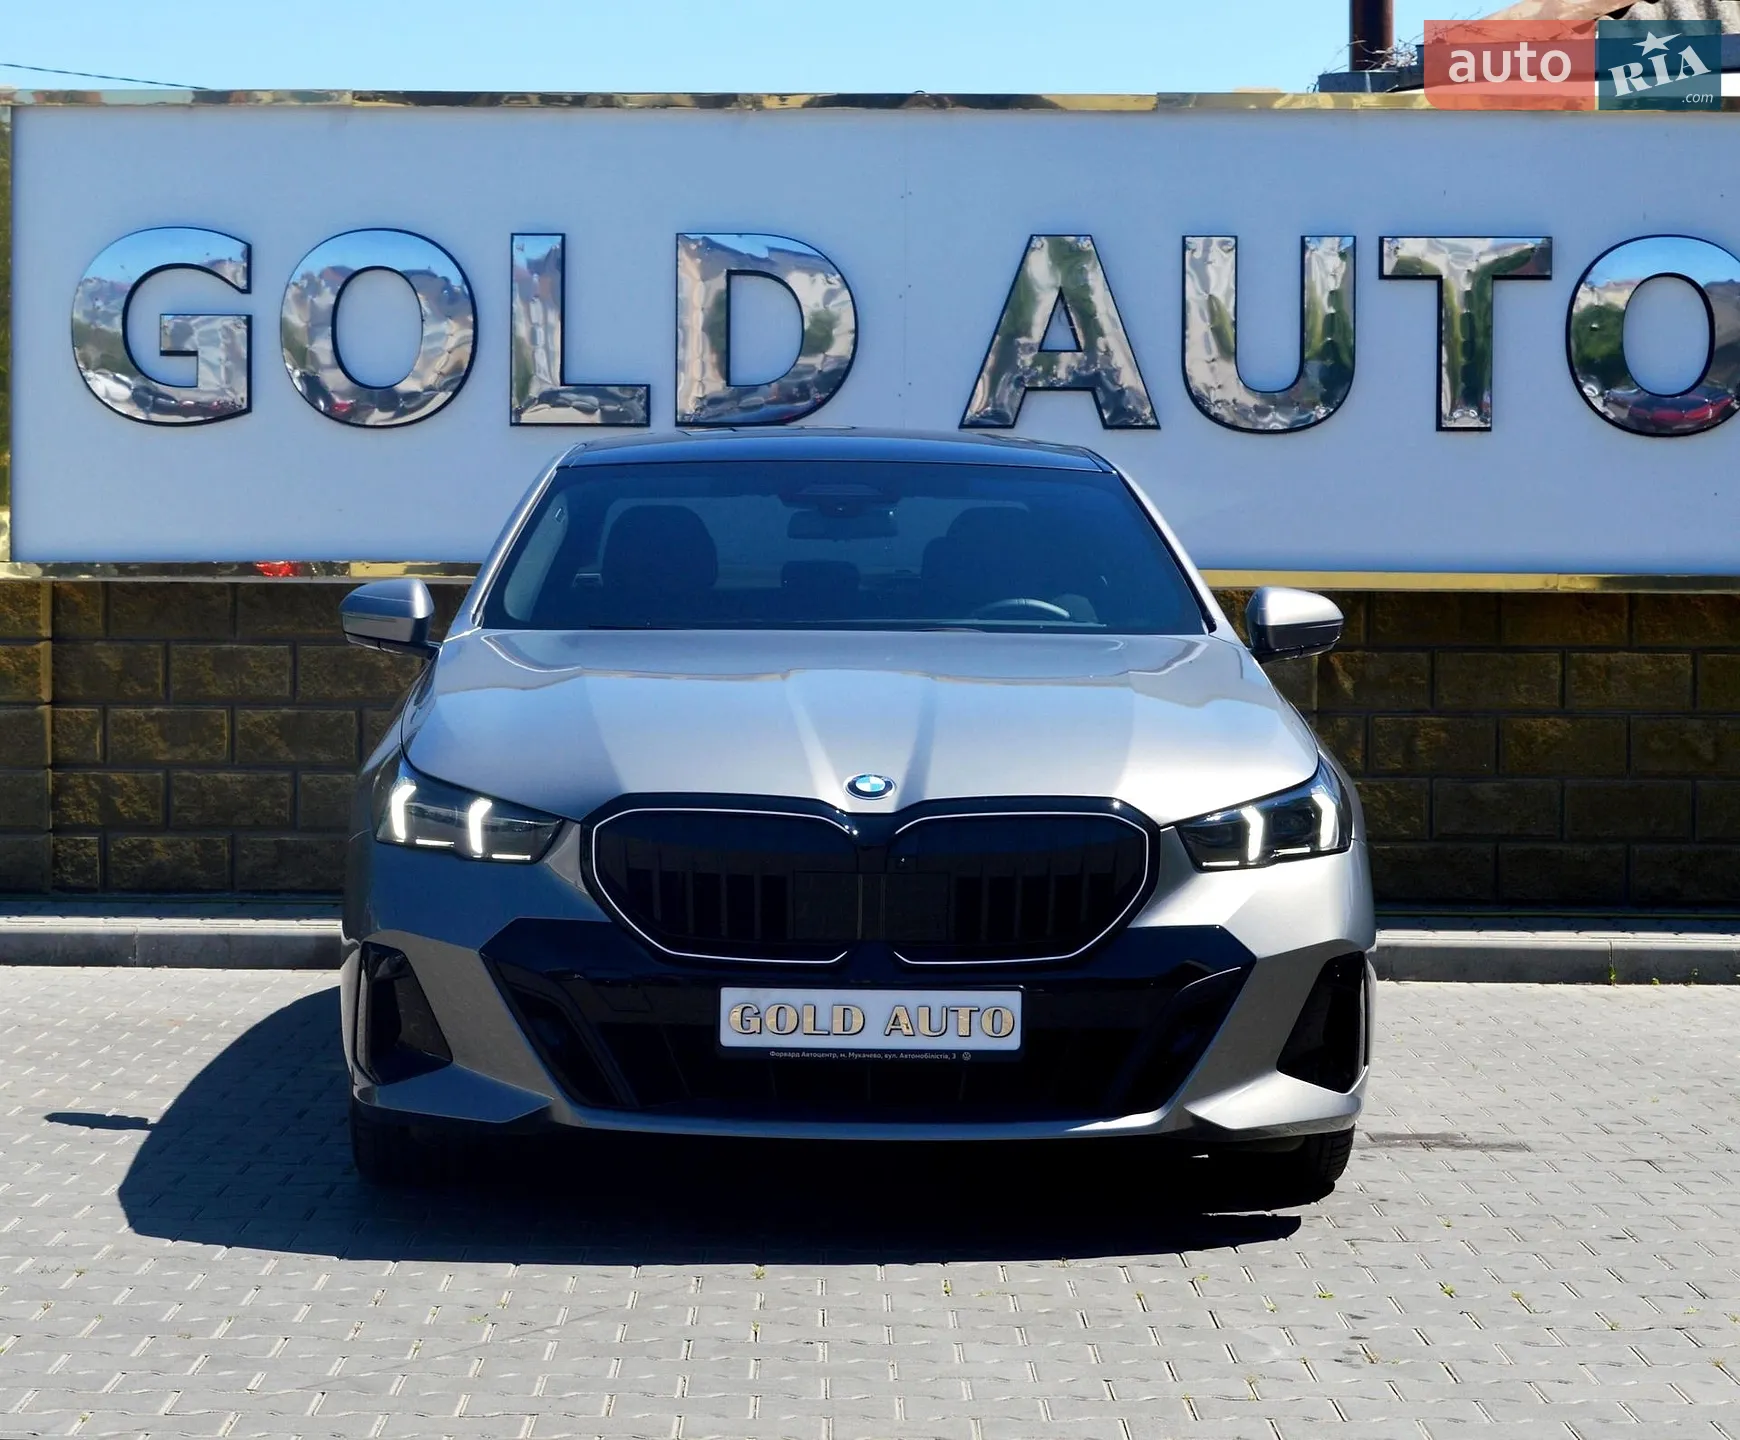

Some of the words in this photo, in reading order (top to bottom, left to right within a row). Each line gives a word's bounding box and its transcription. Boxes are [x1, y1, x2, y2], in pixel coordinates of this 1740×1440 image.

[71, 226, 859, 427] GOLD
[958, 234, 1740, 438] AUTO
[728, 1003, 866, 1036] GOLD
[884, 1006, 1016, 1038] AUTO
